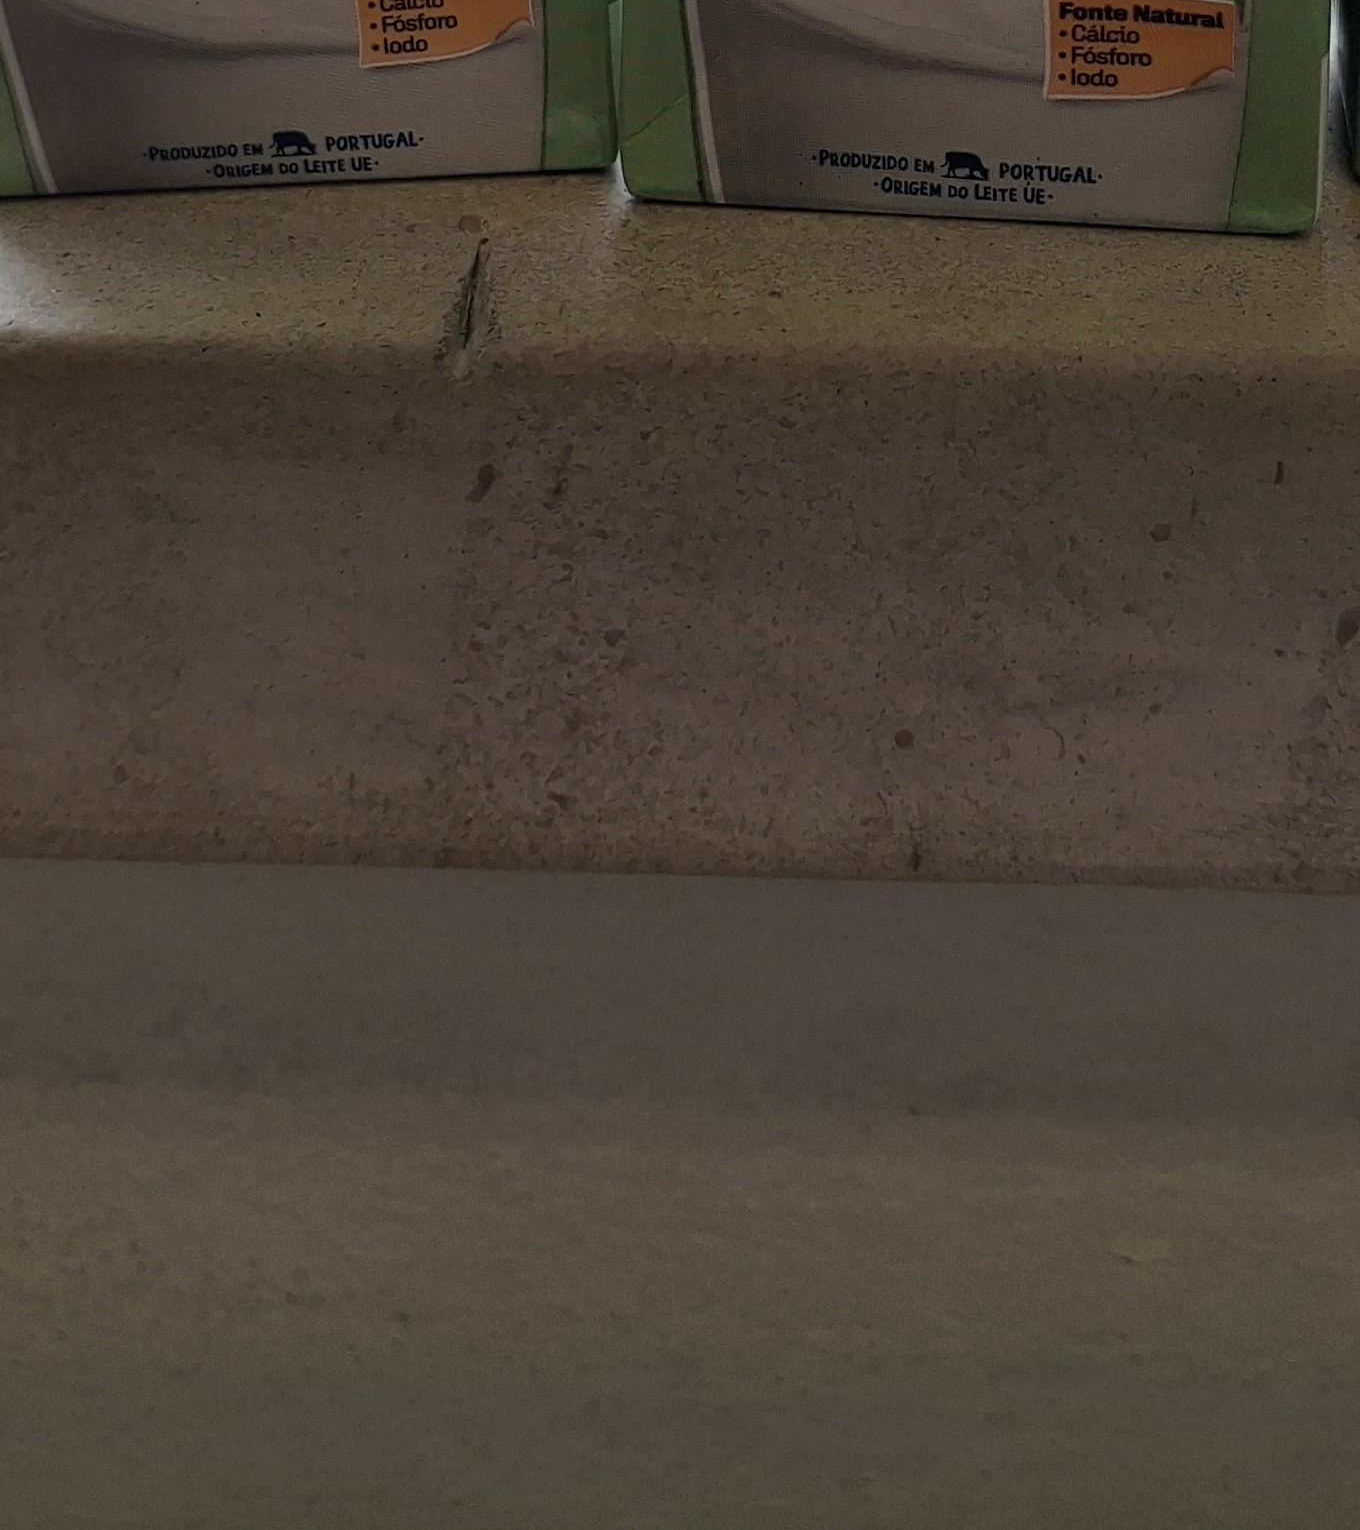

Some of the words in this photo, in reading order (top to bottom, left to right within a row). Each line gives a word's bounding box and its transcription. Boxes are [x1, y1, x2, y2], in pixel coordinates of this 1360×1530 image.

[382, 13, 458, 33] Fósforo
[1059, 2, 1128, 21] Fonte
[1133, 4, 1225, 29] Natural
[1071, 24, 1140, 44] Cálcio
[384, 35, 428, 54] Iodo
[1071, 46, 1152, 66] Fósforo
[1071, 68, 1118, 87] Iodo
[243, 143, 263, 157] EM
[279, 162, 299, 175] DO
[914, 158, 935, 174] EM
[948, 184, 968, 199] DO
